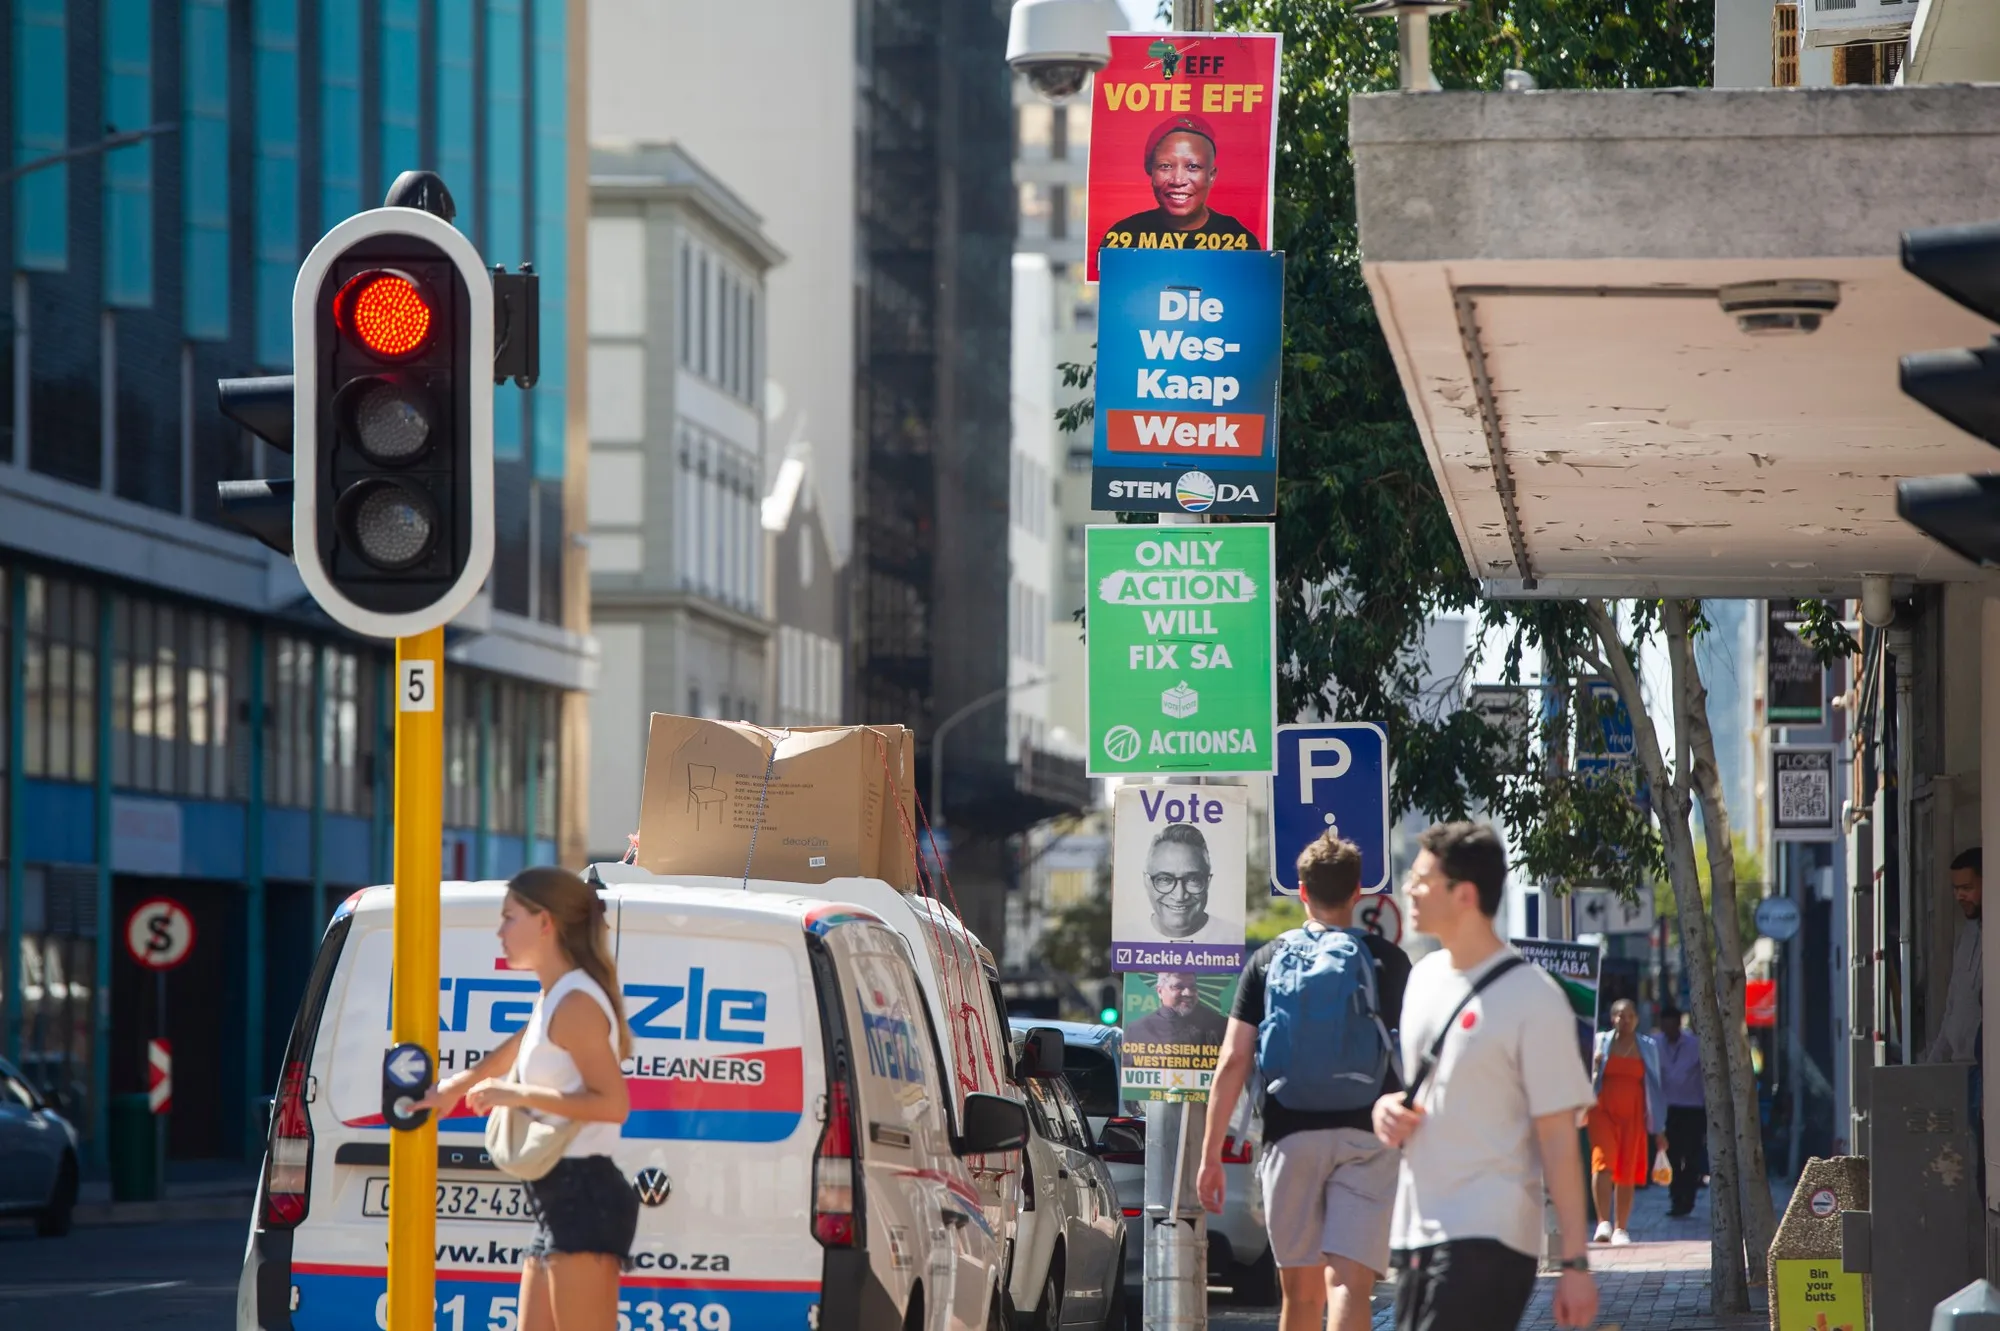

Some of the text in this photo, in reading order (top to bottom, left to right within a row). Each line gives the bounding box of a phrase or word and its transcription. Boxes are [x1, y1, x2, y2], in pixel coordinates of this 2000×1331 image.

[1185, 55, 1225, 75] EFF
[1103, 82, 1264, 113] VOTE EFF
[1106, 231, 1248, 250] 29 MAY 2024
[1159, 290, 1224, 322] Die
[1139, 329, 1241, 361] Wes-
[1137, 368, 1240, 407] Kaap
[1133, 415, 1240, 448] Werk
[1108, 480, 1260, 503] STEM DA
[1135, 540, 1224, 566] ONLY
[1118, 575, 1241, 601] ACTION
[1142, 610, 1219, 635] WILL
[1129, 644, 1233, 670] FIX SA
[408, 668, 425, 702] 5
[1148, 728, 1257, 754] ACTIONSA
[1299, 737, 1352, 804] P
[1777, 753, 1829, 769] FLOCK
[1139, 789, 1224, 824] Vote
[145, 914, 174, 951] S
[1136, 949, 1241, 967] Zackie Achmat
[1122, 1042, 1146, 1054] CDE
[1147, 1043, 1200, 1056] CASSIEM
[1133, 1055, 1190, 1068] WESTERN
[621, 1055, 763, 1083] CLEANERS
[1125, 1070, 1161, 1085] VOTE
[1150, 1090, 1162, 1100] 29
[1810, 1268, 1829, 1279] Bin
[1805, 1292, 1836, 1303] butts
[1806, 1281, 1833, 1293] your
